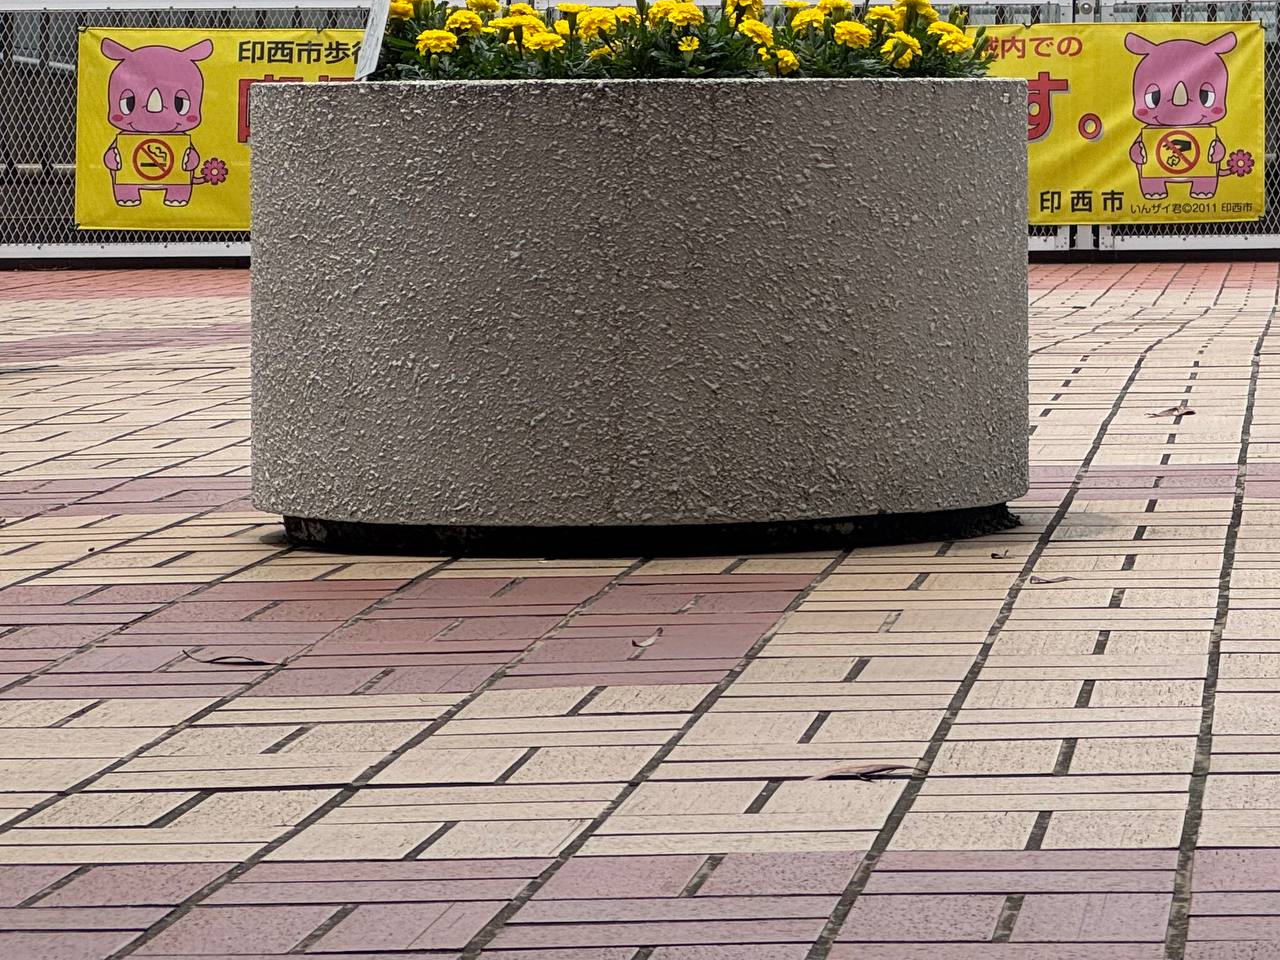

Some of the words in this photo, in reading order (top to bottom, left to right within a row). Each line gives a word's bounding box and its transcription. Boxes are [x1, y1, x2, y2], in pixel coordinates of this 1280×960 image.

[1040, 189, 1125, 213] 印西市
[1221, 202, 1253, 213] 印西市
